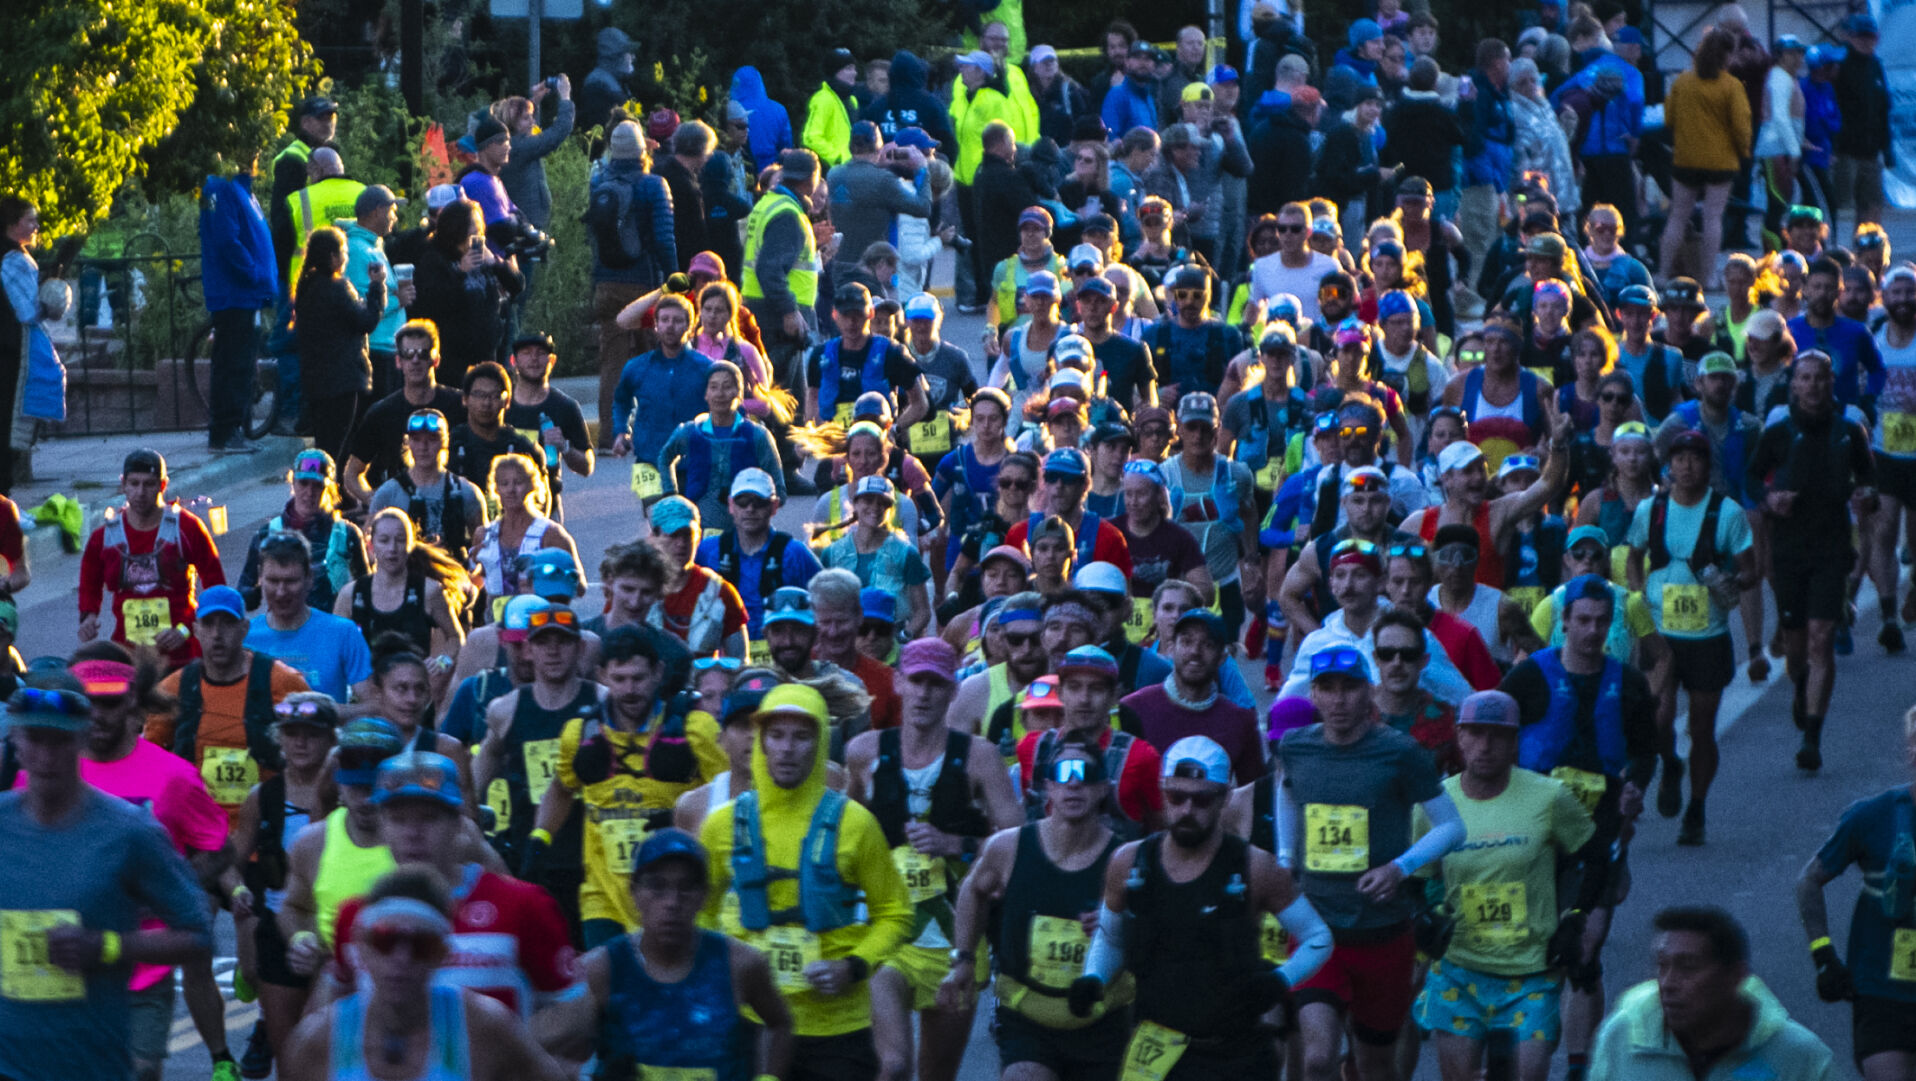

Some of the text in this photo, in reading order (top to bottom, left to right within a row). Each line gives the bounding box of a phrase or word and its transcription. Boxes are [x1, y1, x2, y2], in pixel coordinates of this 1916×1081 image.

[922, 423, 938, 437] 50
[216, 764, 246, 782] 132
[1318, 826, 1352, 846] 134
[617, 841, 641, 860] 17
[906, 868, 931, 888] 58
[1477, 902, 1512, 922] 129
[1047, 941, 1086, 964] 198
